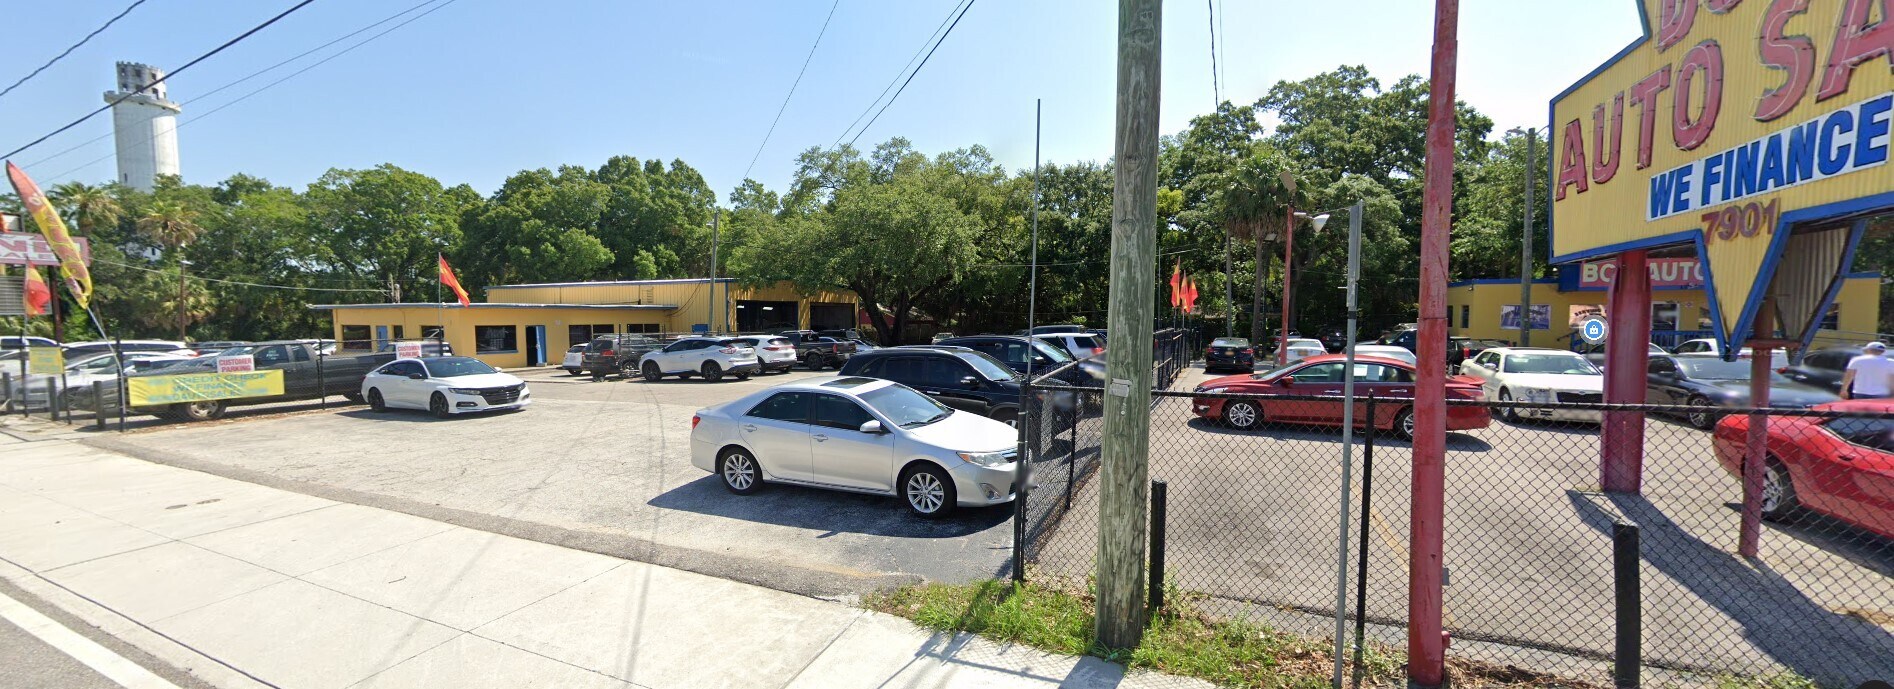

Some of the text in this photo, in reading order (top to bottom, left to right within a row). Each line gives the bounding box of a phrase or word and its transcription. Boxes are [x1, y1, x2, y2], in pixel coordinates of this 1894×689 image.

[1554, 39, 1723, 201] AUTO
[1650, 95, 1894, 219] WE FINANCE
[1701, 198, 1780, 245] 7901
[219, 357, 252, 366] CUSTOMER
